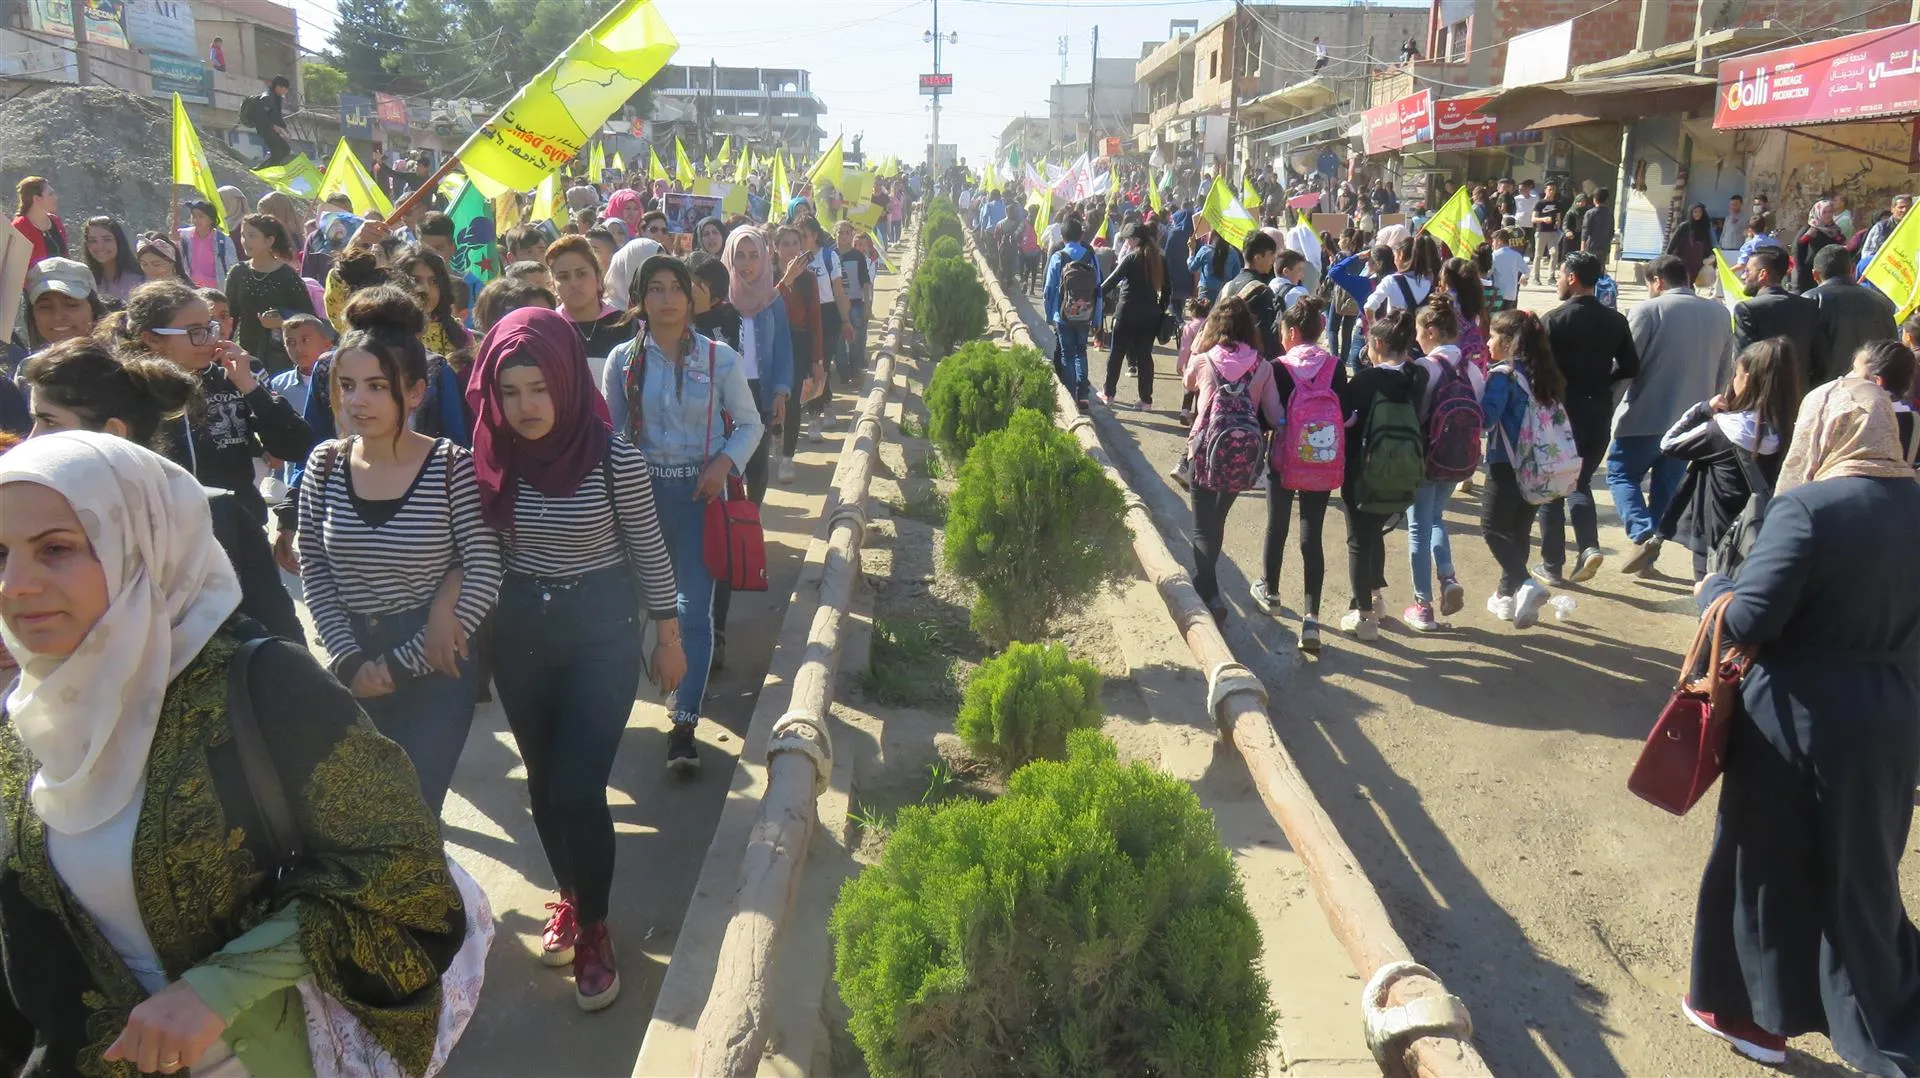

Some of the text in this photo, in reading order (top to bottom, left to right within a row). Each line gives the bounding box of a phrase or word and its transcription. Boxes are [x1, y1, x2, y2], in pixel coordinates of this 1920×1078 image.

[1773, 74, 1804, 88] MONTAGE
[1728, 67, 1769, 110] dalli
[1772, 87, 1809, 101] PRODUCTION
[206, 390, 244, 405] ROYAL
[660, 466, 684, 478] LOVE
